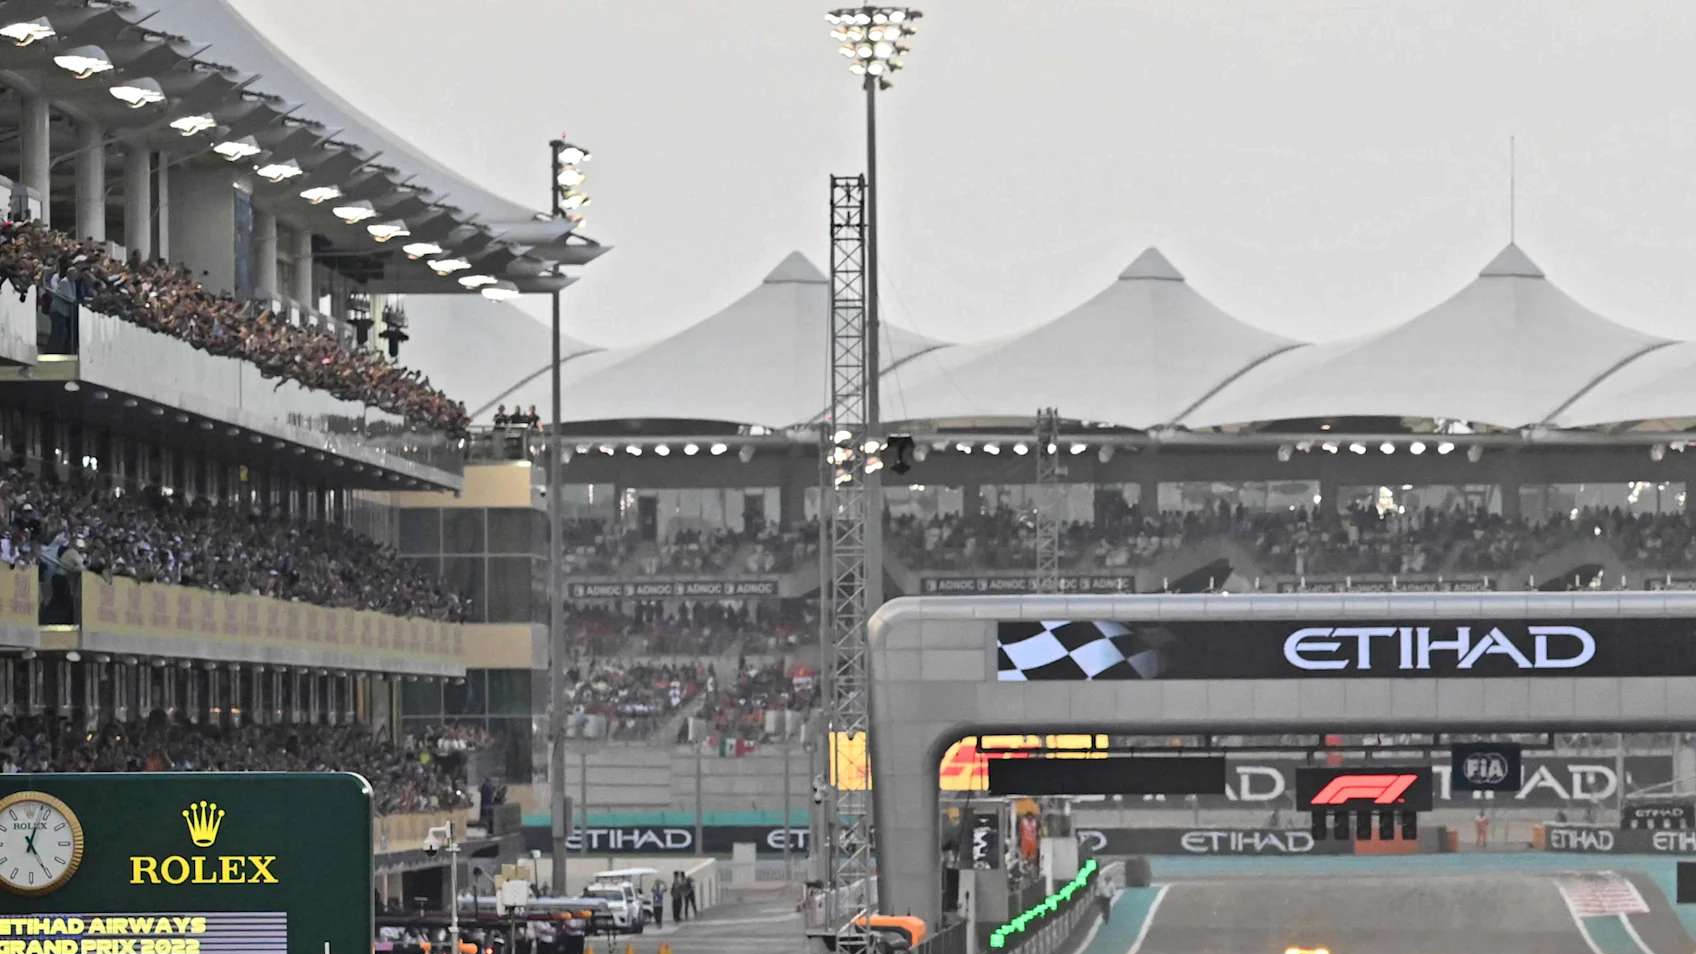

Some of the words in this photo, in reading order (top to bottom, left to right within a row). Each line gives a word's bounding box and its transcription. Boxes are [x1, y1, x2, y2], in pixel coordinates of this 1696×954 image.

[1284, 627, 1595, 669] ETIHAD
[565, 829, 692, 850] ETIHAD
[1181, 831, 1315, 852] ETIHAD
[130, 855, 279, 884] ROLEX
[0, 918, 84, 935] ETIHAD
[88, 917, 207, 934] AIRWAYS
